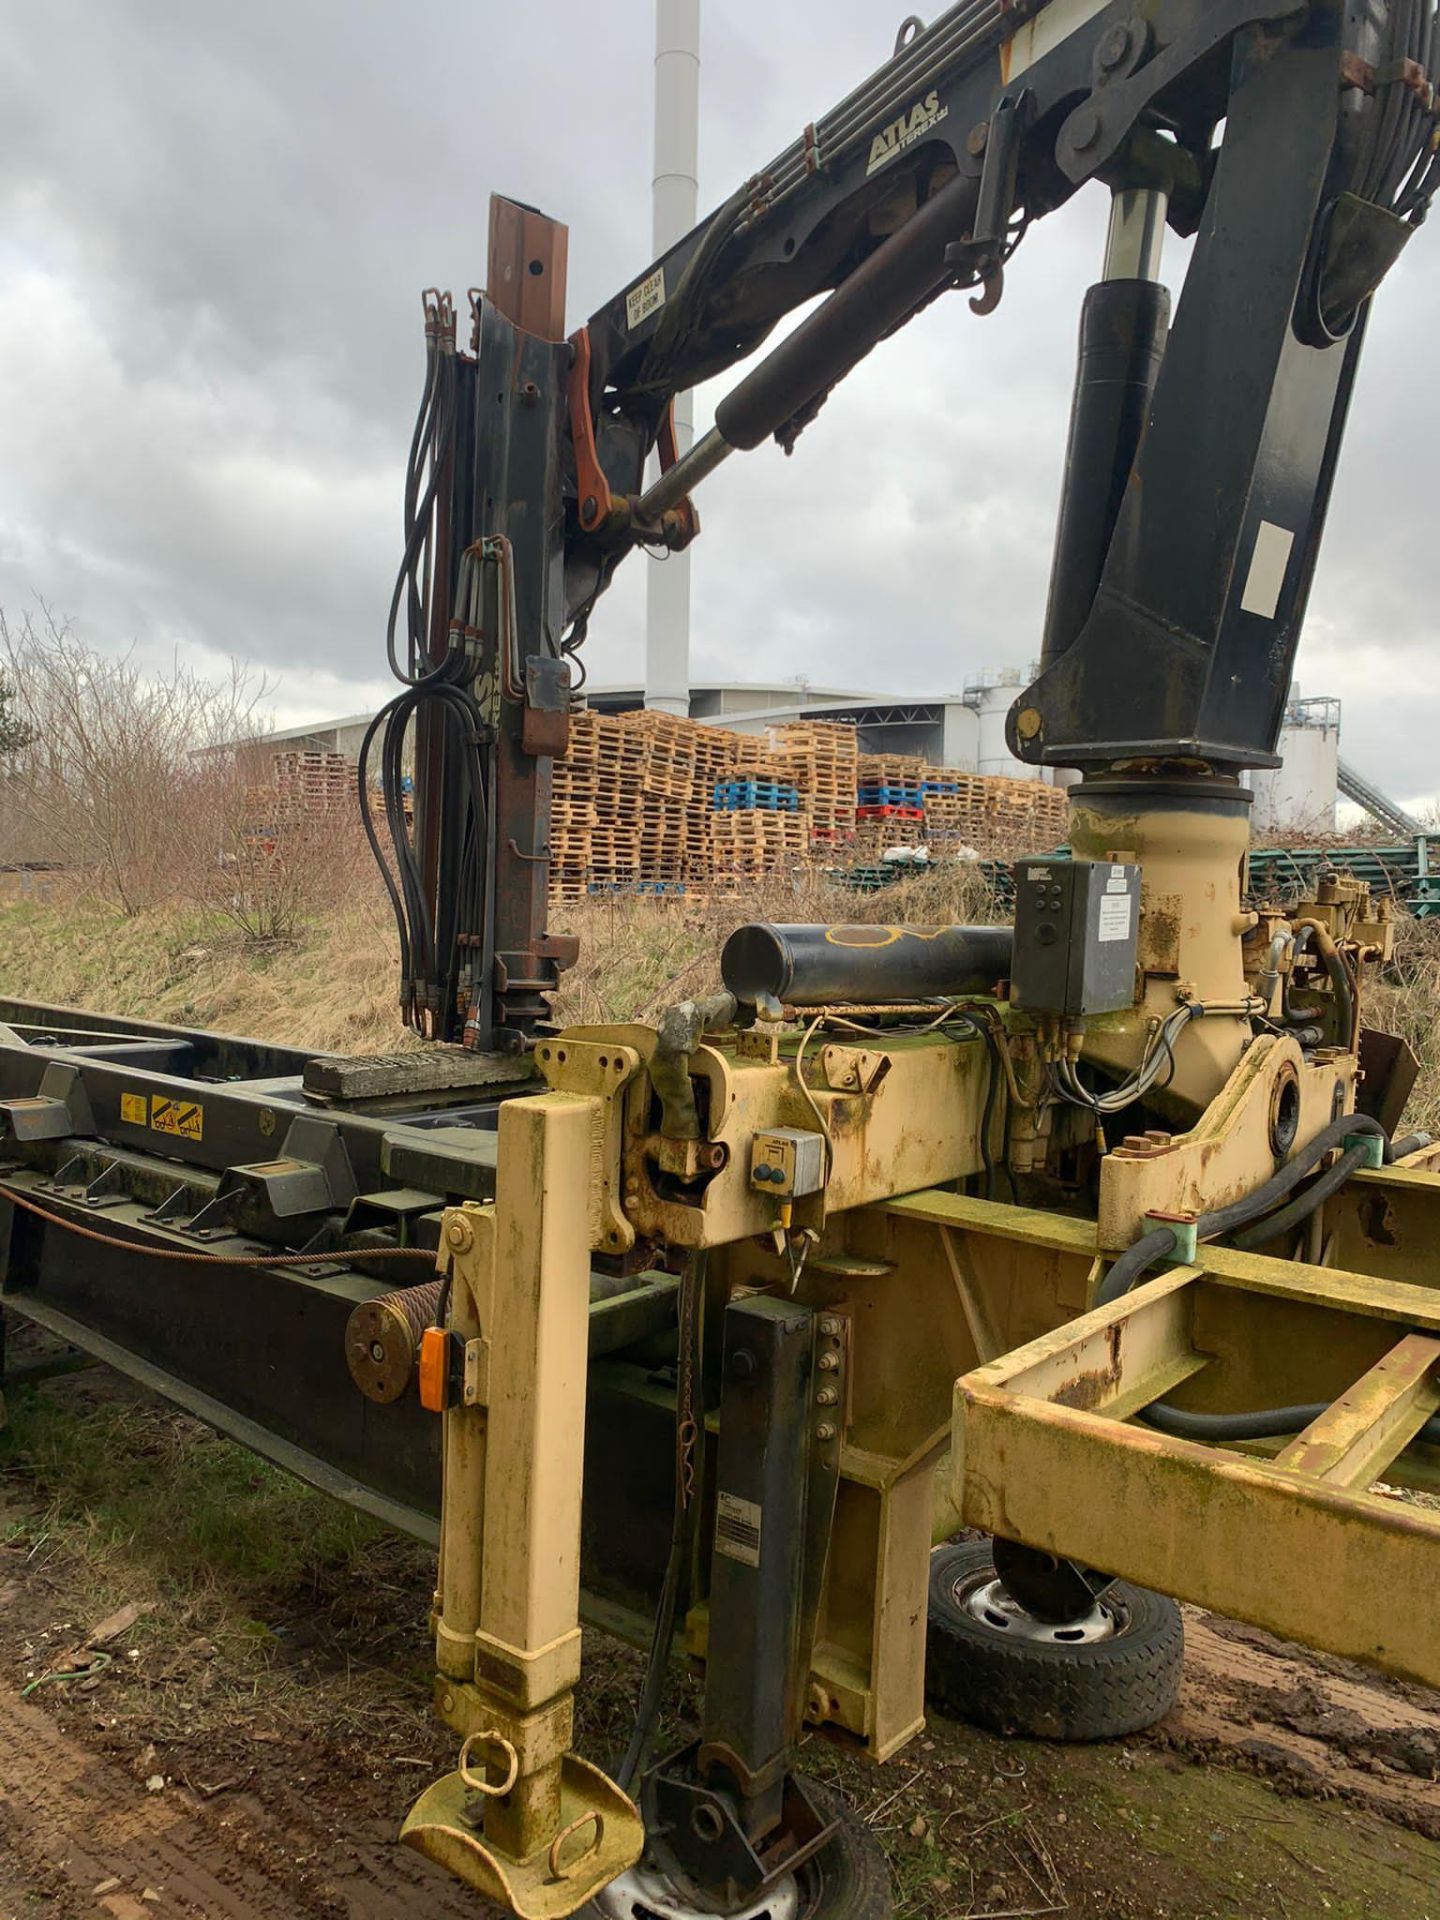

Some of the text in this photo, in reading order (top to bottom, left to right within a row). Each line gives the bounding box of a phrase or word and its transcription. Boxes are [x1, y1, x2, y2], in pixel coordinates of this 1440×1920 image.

[867, 89, 940, 166] ATLAS
[899, 114, 937, 149] TEREX
[629, 288, 642, 309] KEEP
